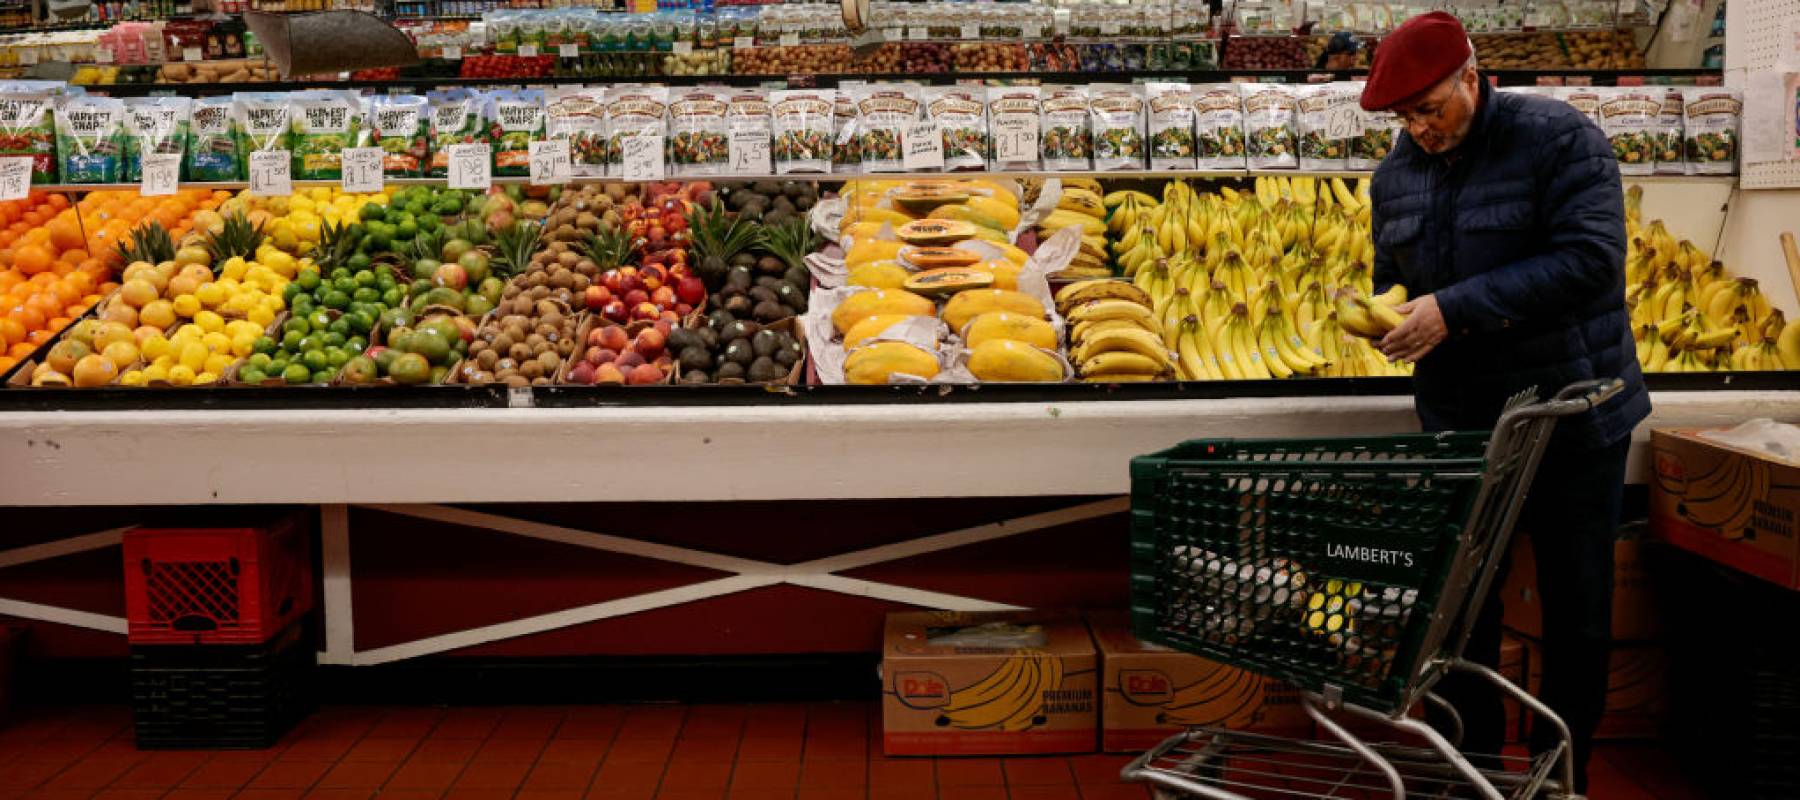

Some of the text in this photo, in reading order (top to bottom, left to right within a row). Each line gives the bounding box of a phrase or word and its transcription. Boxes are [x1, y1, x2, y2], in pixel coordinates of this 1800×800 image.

[500, 106, 540, 117] HARVEST
[311, 118, 342, 128] SNPS
[1327, 543, 1414, 568] LAMBERT'S
[903, 680, 945, 695] Dole
[1128, 675, 1169, 693] Dole
[1042, 690, 1093, 702] PREMIUM
[1042, 703, 1093, 714] BANANAS
